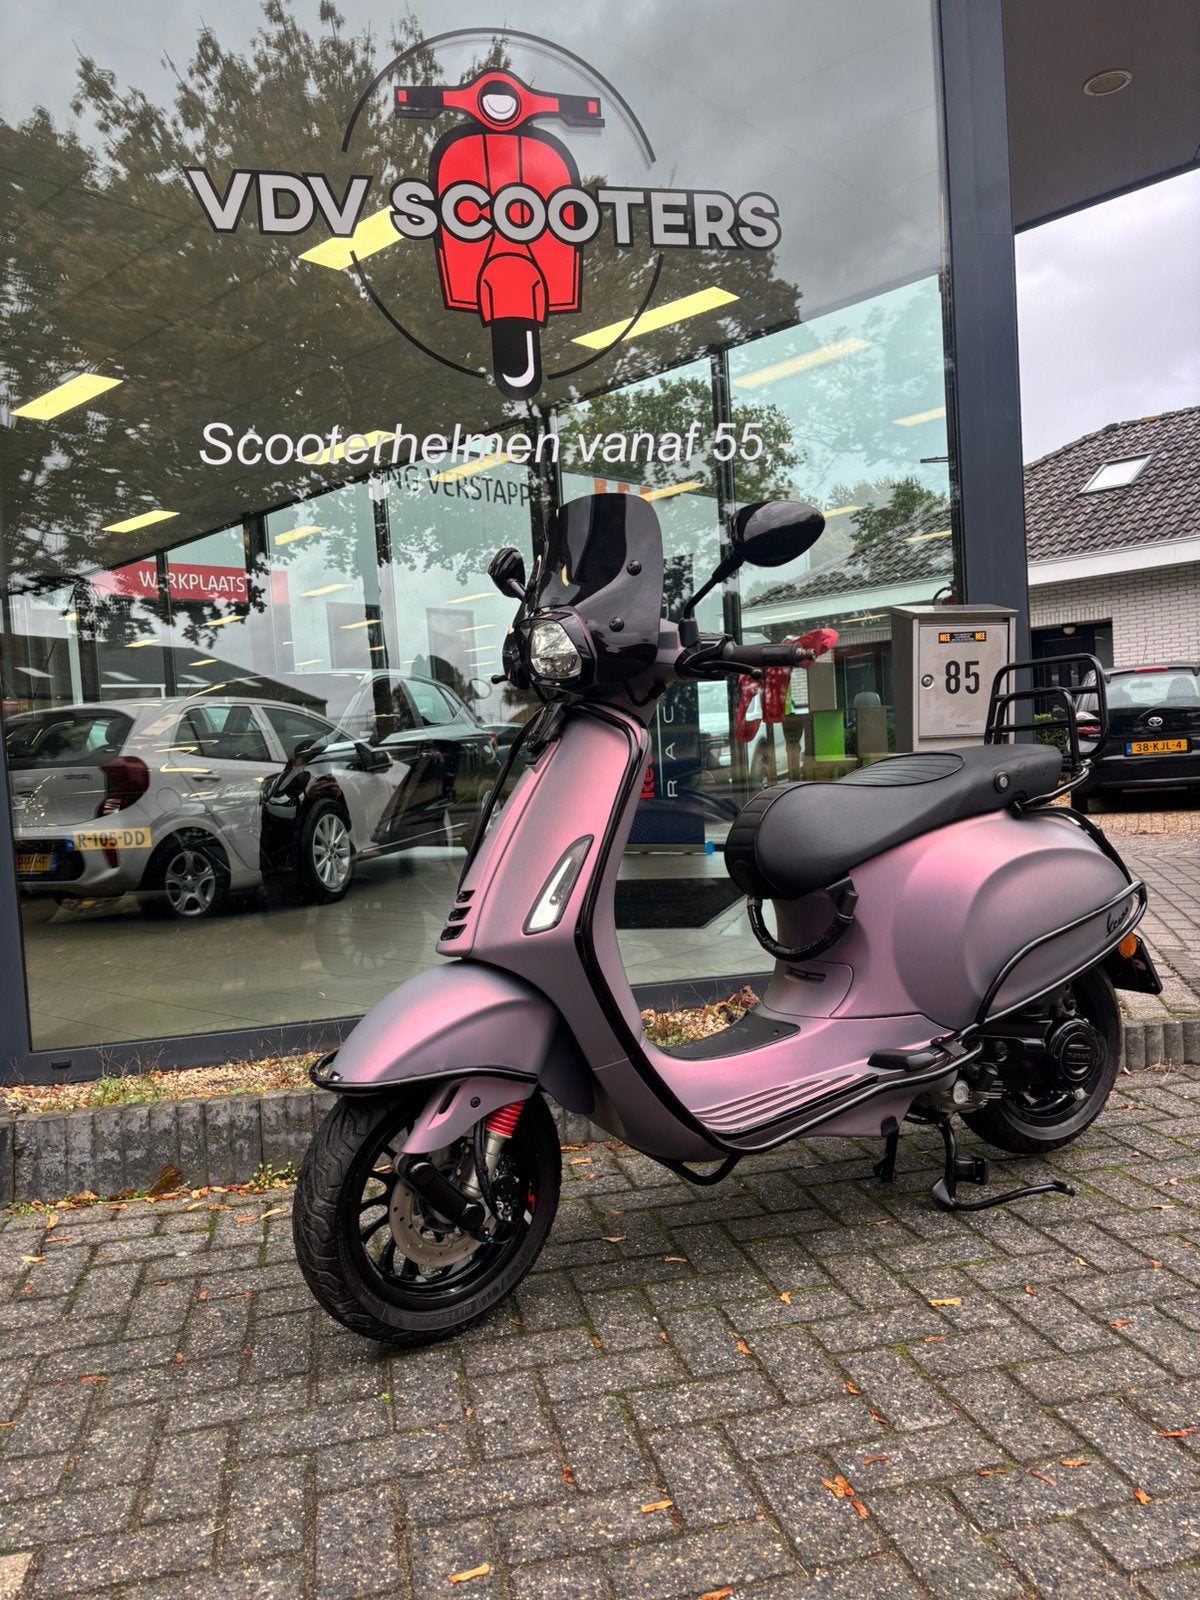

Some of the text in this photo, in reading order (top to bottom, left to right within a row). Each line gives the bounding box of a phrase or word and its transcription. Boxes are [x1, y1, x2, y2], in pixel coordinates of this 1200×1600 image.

[184, 167, 780, 249] VDV SCOOTERS
[199, 422, 559, 466] Scooterhelmen
[577, 422, 700, 463] vanaf
[139, 570, 245, 593] WRKPLAATS
[945, 660, 980, 694] 85
[1136, 741, 1182, 752] 38-KJL-4
[77, 830, 146, 848] R-105-DD
